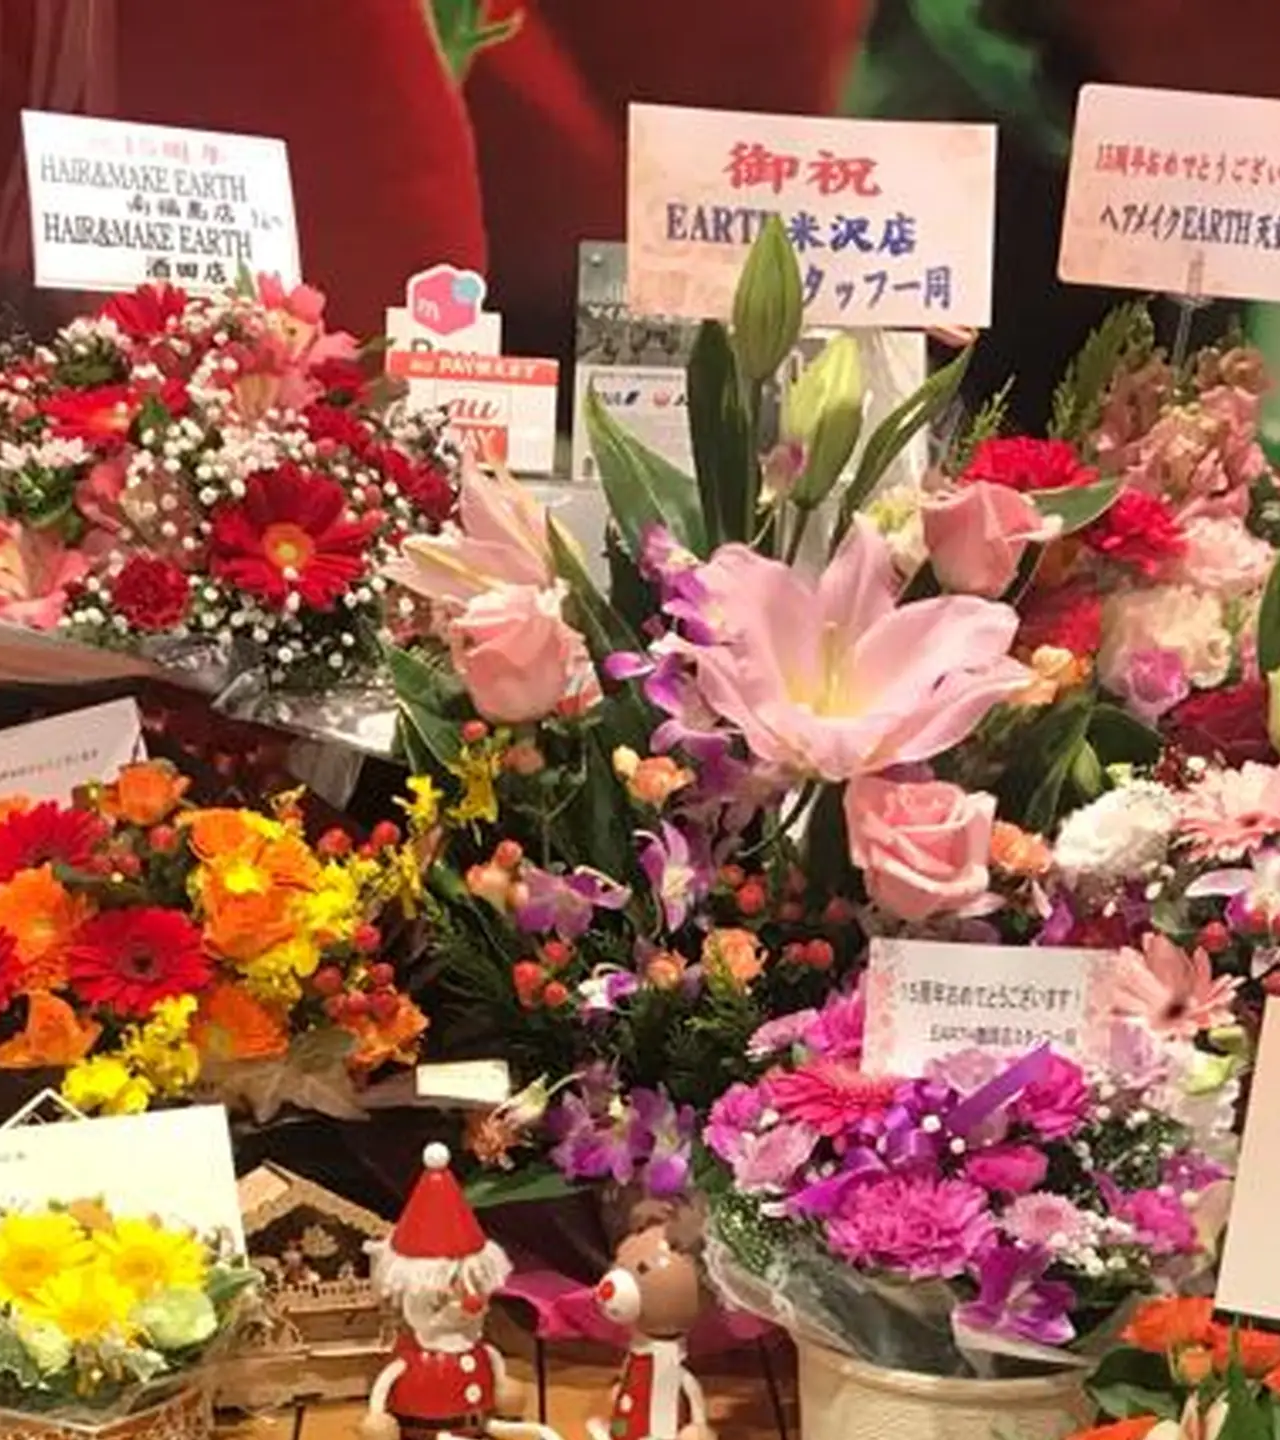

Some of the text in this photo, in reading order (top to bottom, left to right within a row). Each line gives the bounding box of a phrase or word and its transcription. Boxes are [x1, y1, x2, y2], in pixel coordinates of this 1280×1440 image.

[40, 152, 247, 203] HAIR&MAKE EARTH
[722, 140, 883, 198] 御祝
[43, 212, 253, 259] HAIR&MAKE EARTH
[801, 264, 953, 310] タッフ一同
